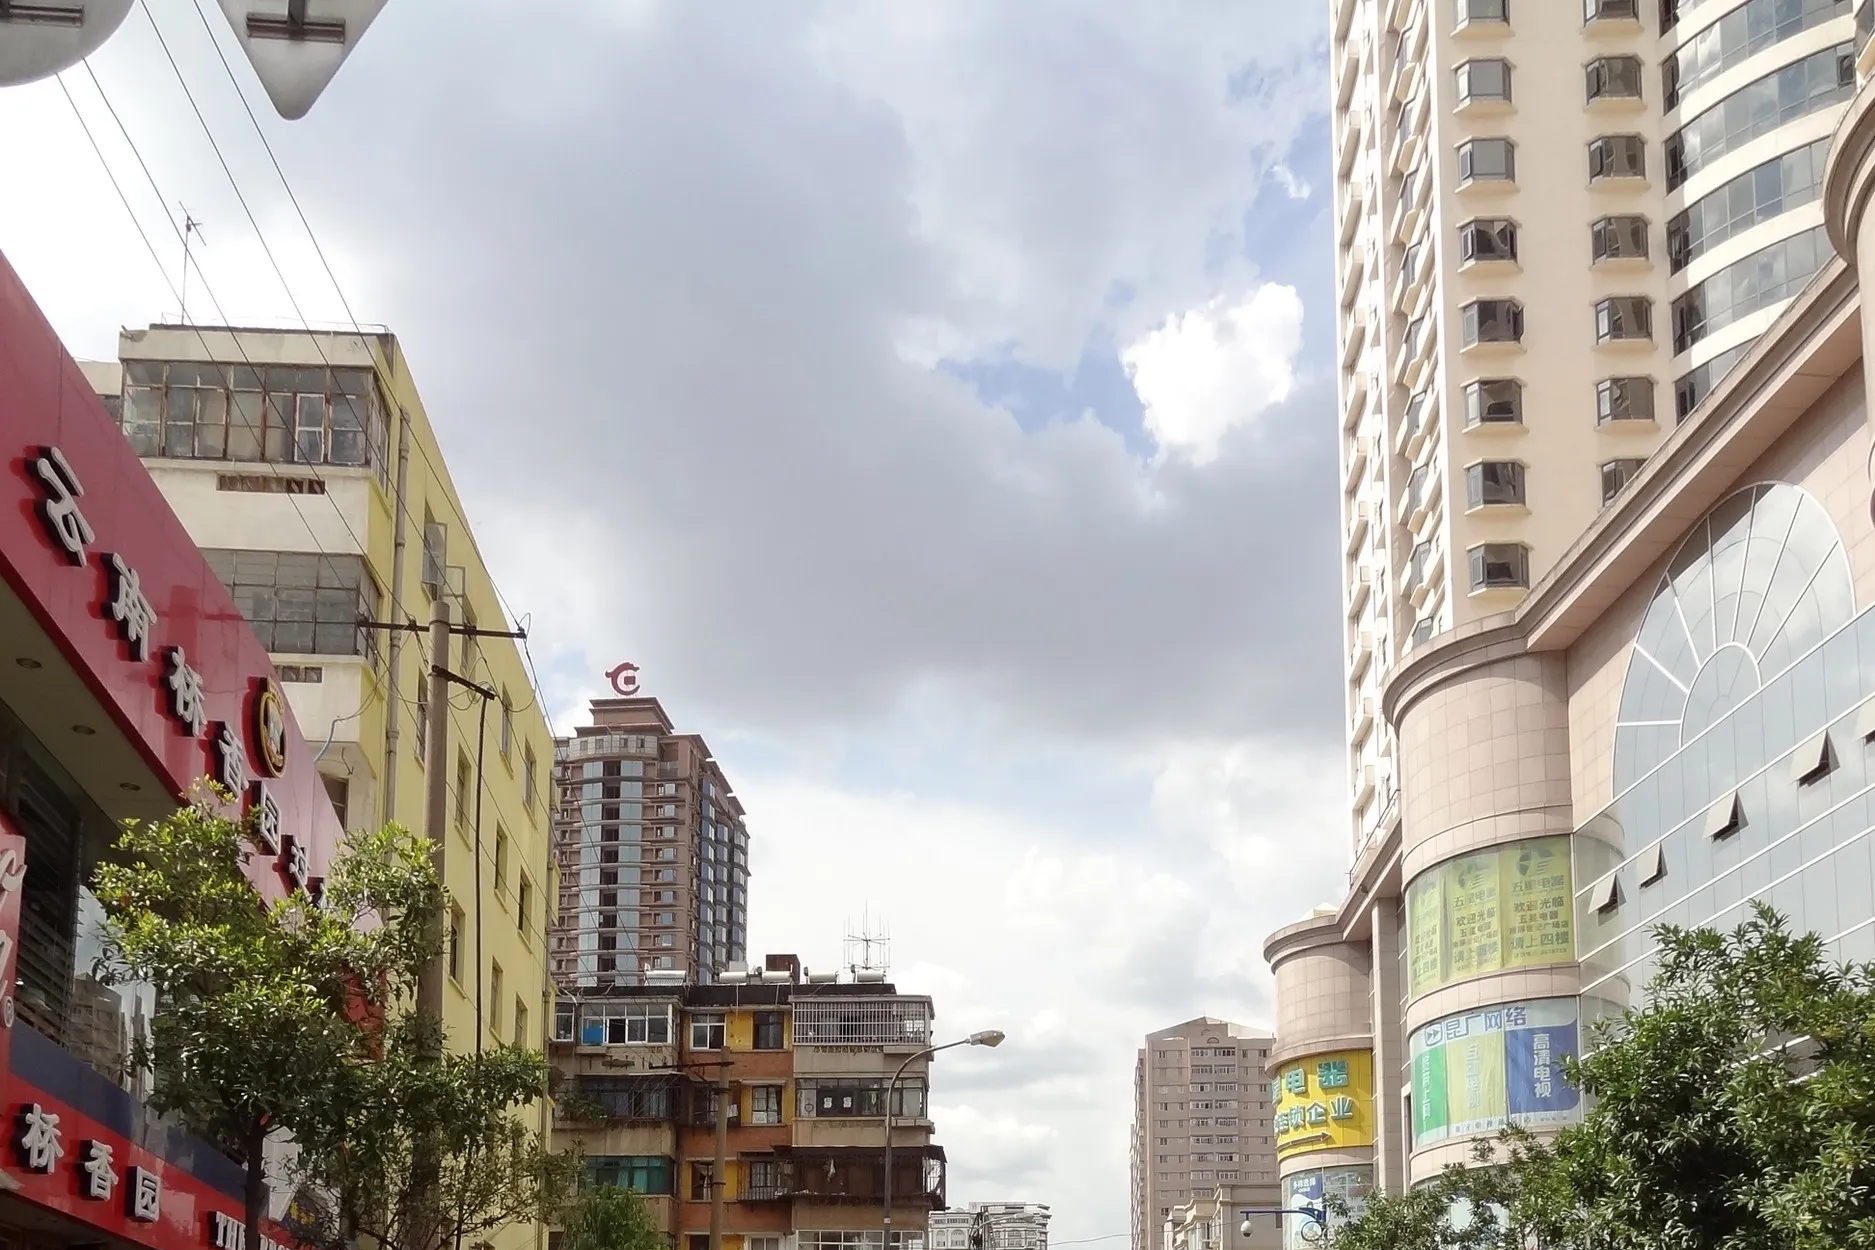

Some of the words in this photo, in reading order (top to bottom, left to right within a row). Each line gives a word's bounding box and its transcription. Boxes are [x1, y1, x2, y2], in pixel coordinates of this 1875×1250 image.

[36, 446, 327, 909] 云南桥香园过
[1455, 907, 1496, 927] 欢迎光临
[1514, 896, 1565, 913] 欢迎光临
[1453, 941, 1498, 964] 请上四楼
[1511, 931, 1570, 950] 请上四楼
[1446, 1006, 1527, 1041] 昆广网络
[1533, 1033, 1552, 1098] 高清电视
[22, 1102, 162, 1223] 桥香园
